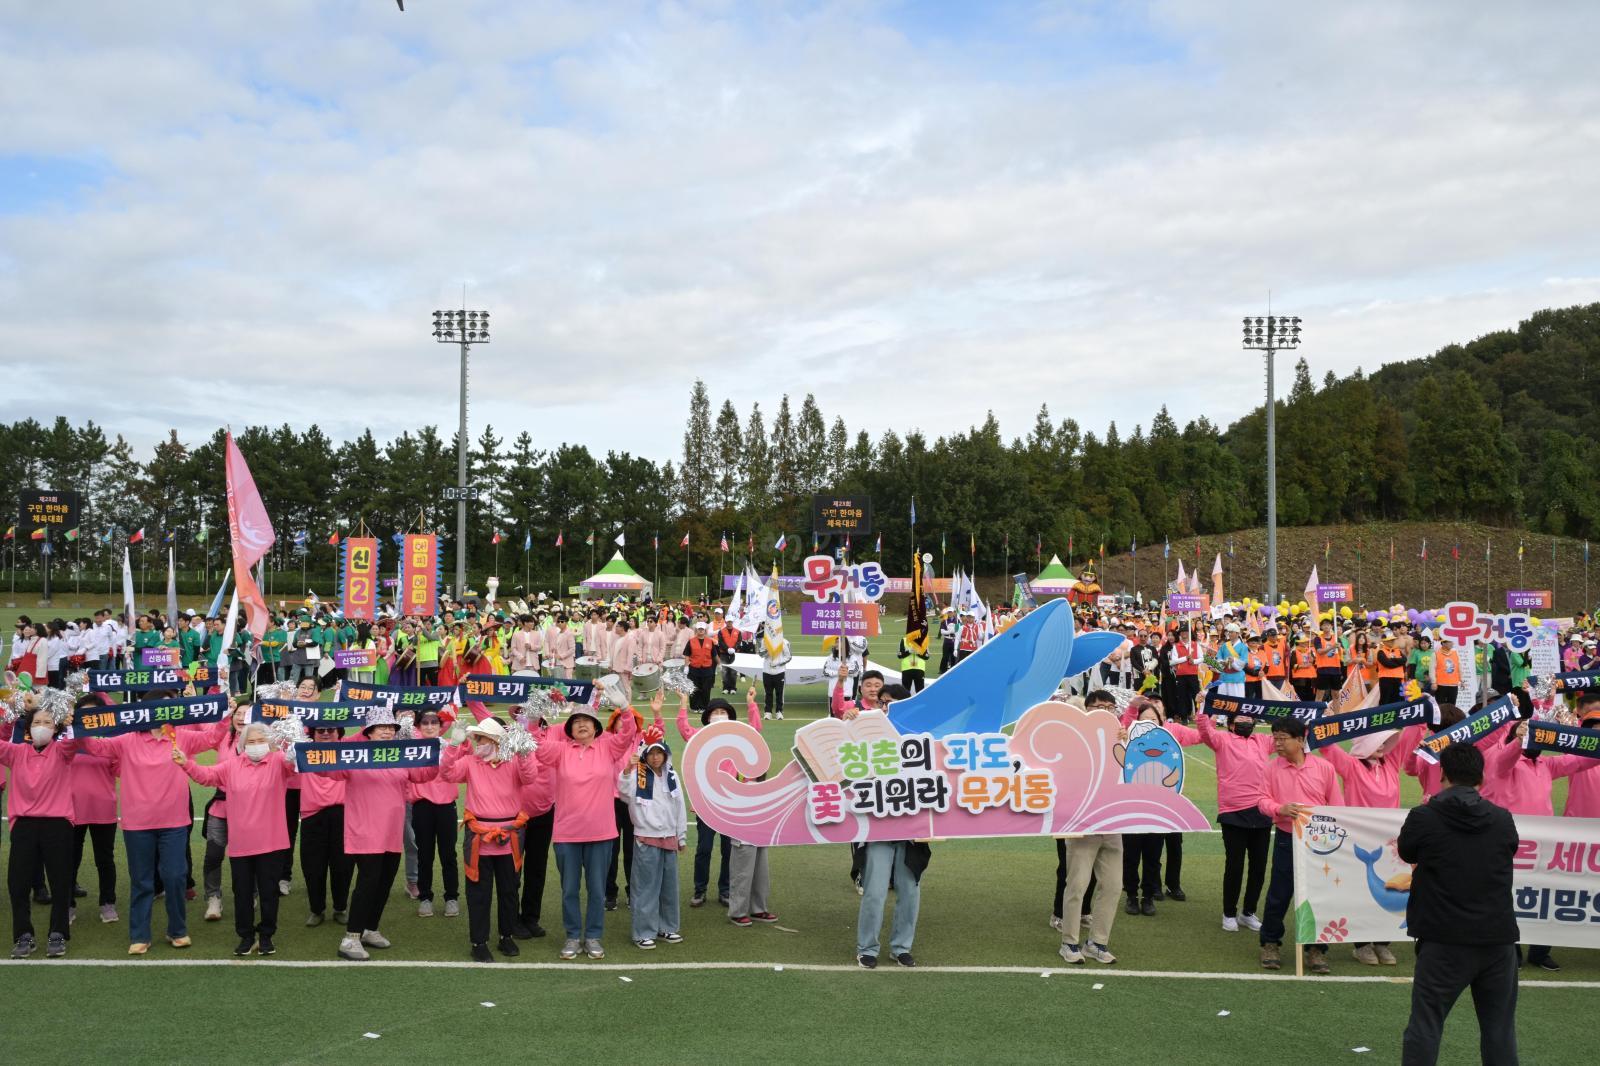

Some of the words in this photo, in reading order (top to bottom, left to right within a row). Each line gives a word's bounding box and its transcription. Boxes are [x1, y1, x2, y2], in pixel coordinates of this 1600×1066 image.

[443, 488, 478, 499] 10:23
[27, 504, 43, 513] 구민
[46, 504, 69, 513] 한마음
[821, 508, 837, 518] 구민
[840, 508, 863, 518] 한마음
[32, 514, 64, 523] 체육대회
[827, 519, 858, 528] 체육대회
[804, 559, 885, 600] 무거동
[1323, 590, 1347, 599] 신정3동
[1515, 597, 1543, 606] 신정5동
[847, 609, 863, 619] 구민
[1443, 605, 1533, 648] 무거동
[96, 673, 122, 686] 무거
[125, 671, 150, 685] 최강
[153, 670, 178, 684] 무거
[1565, 676, 1591, 689] 무거
[347, 687, 374, 700] 함께
[401, 691, 427, 705] 최강
[428, 691, 452, 704] 무거
[466, 681, 494, 695] 함께
[498, 682, 525, 697] 무거
[81, 711, 117, 730] 함께
[120, 708, 151, 725] 무거
[154, 705, 186, 721] 최강
[189, 701, 219, 718] 무거
[261, 703, 290, 719] 함께
[293, 706, 320, 721] 무거
[322, 707, 350, 721] 최강
[1212, 699, 1239, 714] 함께
[1240, 703, 1265, 715] 무거
[1266, 706, 1292, 718] 최강
[1292, 707, 1318, 720] 무거
[1313, 722, 1340, 741] 함께
[1342, 717, 1368, 732] 무거
[1370, 710, 1397, 727] 최강
[1398, 703, 1425, 720] 무거
[1429, 734, 1451, 753] 함께
[1450, 725, 1472, 743] 무거
[1470, 715, 1491, 735] 최강
[1490, 704, 1510, 724] 무거
[1535, 728, 1557, 745] 함께
[1557, 732, 1578, 748] 무거
[1577, 735, 1599, 751] 최강
[306, 749, 337, 765] 함께
[340, 748, 369, 764] 무거
[373, 748, 401, 763] 최강
[404, 745, 432, 761] 무거
[838, 737, 932, 779] 청춘의
[947, 737, 1022, 773] 파도,
[811, 783, 842, 820] 꽃
[853, 775, 948, 814] 피워라
[960, 773, 1054, 810] 무거동
